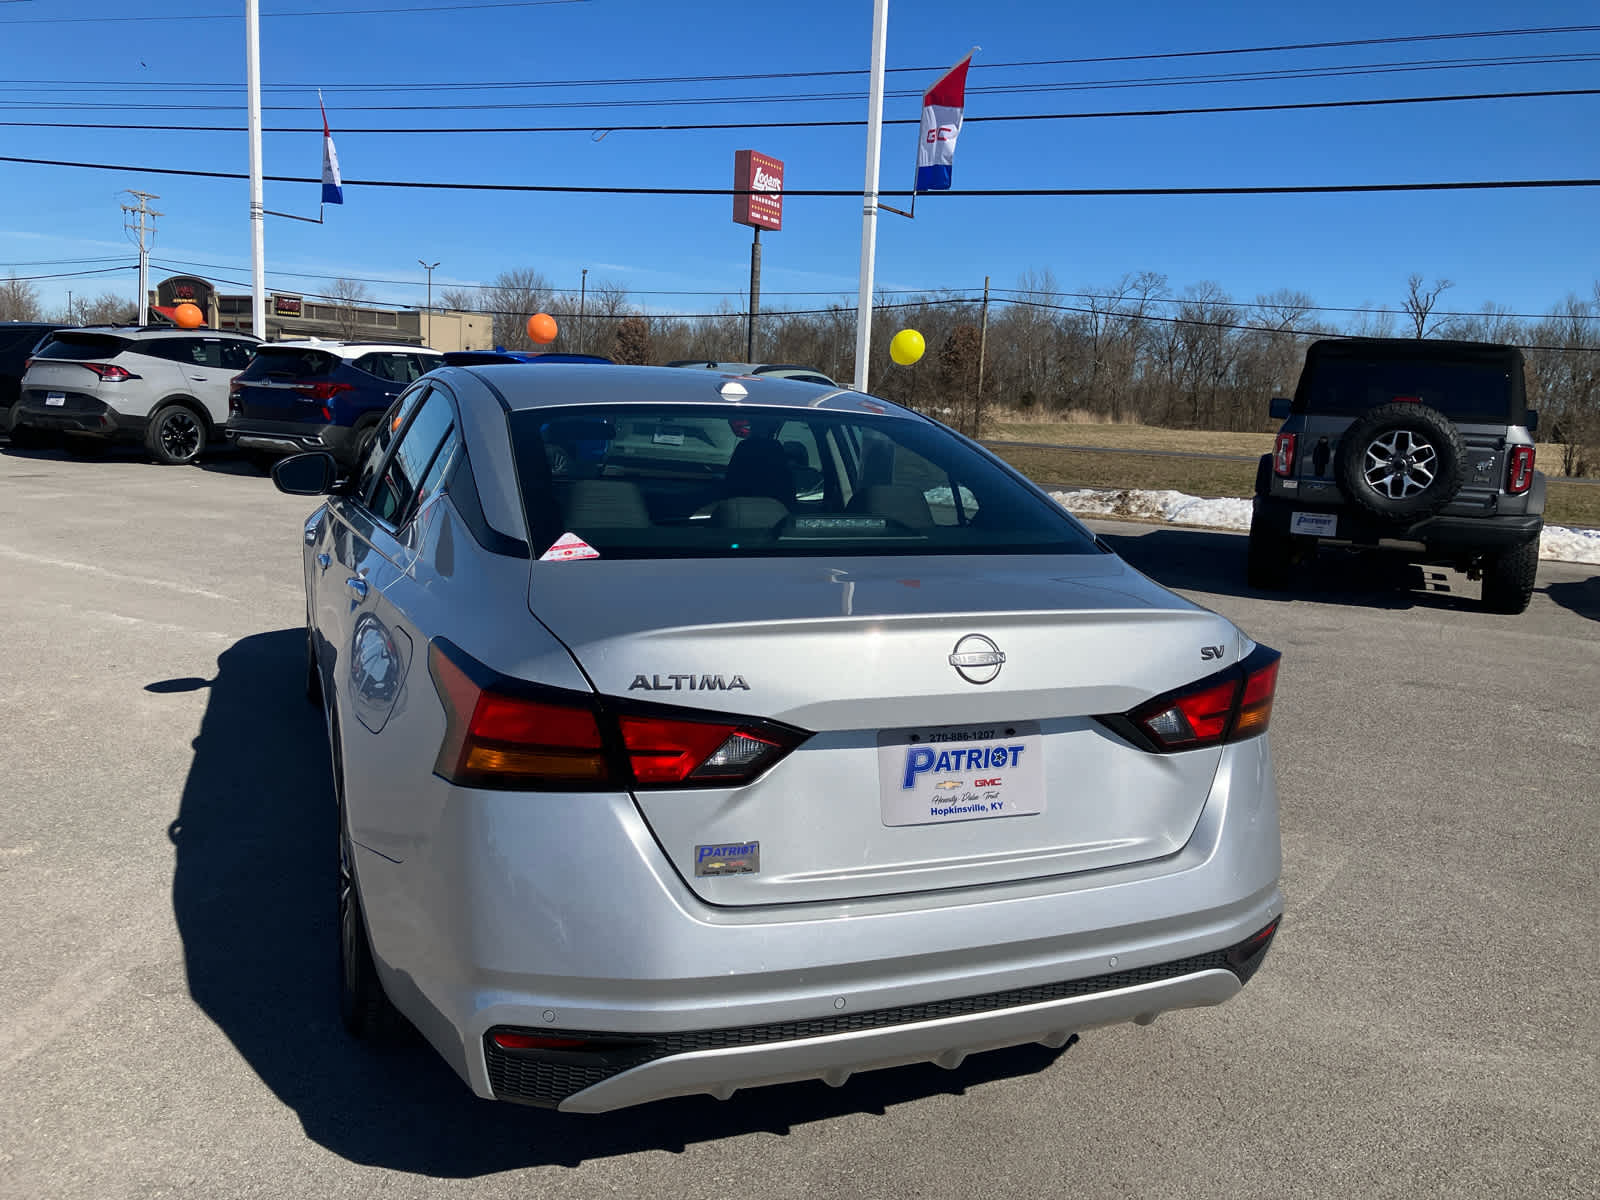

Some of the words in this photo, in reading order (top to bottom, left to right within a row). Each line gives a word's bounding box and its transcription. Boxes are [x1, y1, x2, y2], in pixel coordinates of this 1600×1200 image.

[1200, 645, 1225, 661] SV
[628, 674, 751, 690] ALTIMA
[902, 745, 1025, 790] PATRIOT
[974, 777, 1002, 788] GMC
[930, 803, 989, 816] Hopkinsville,
[990, 801, 1004, 810] KY
[698, 843, 756, 863] PATRIOT
